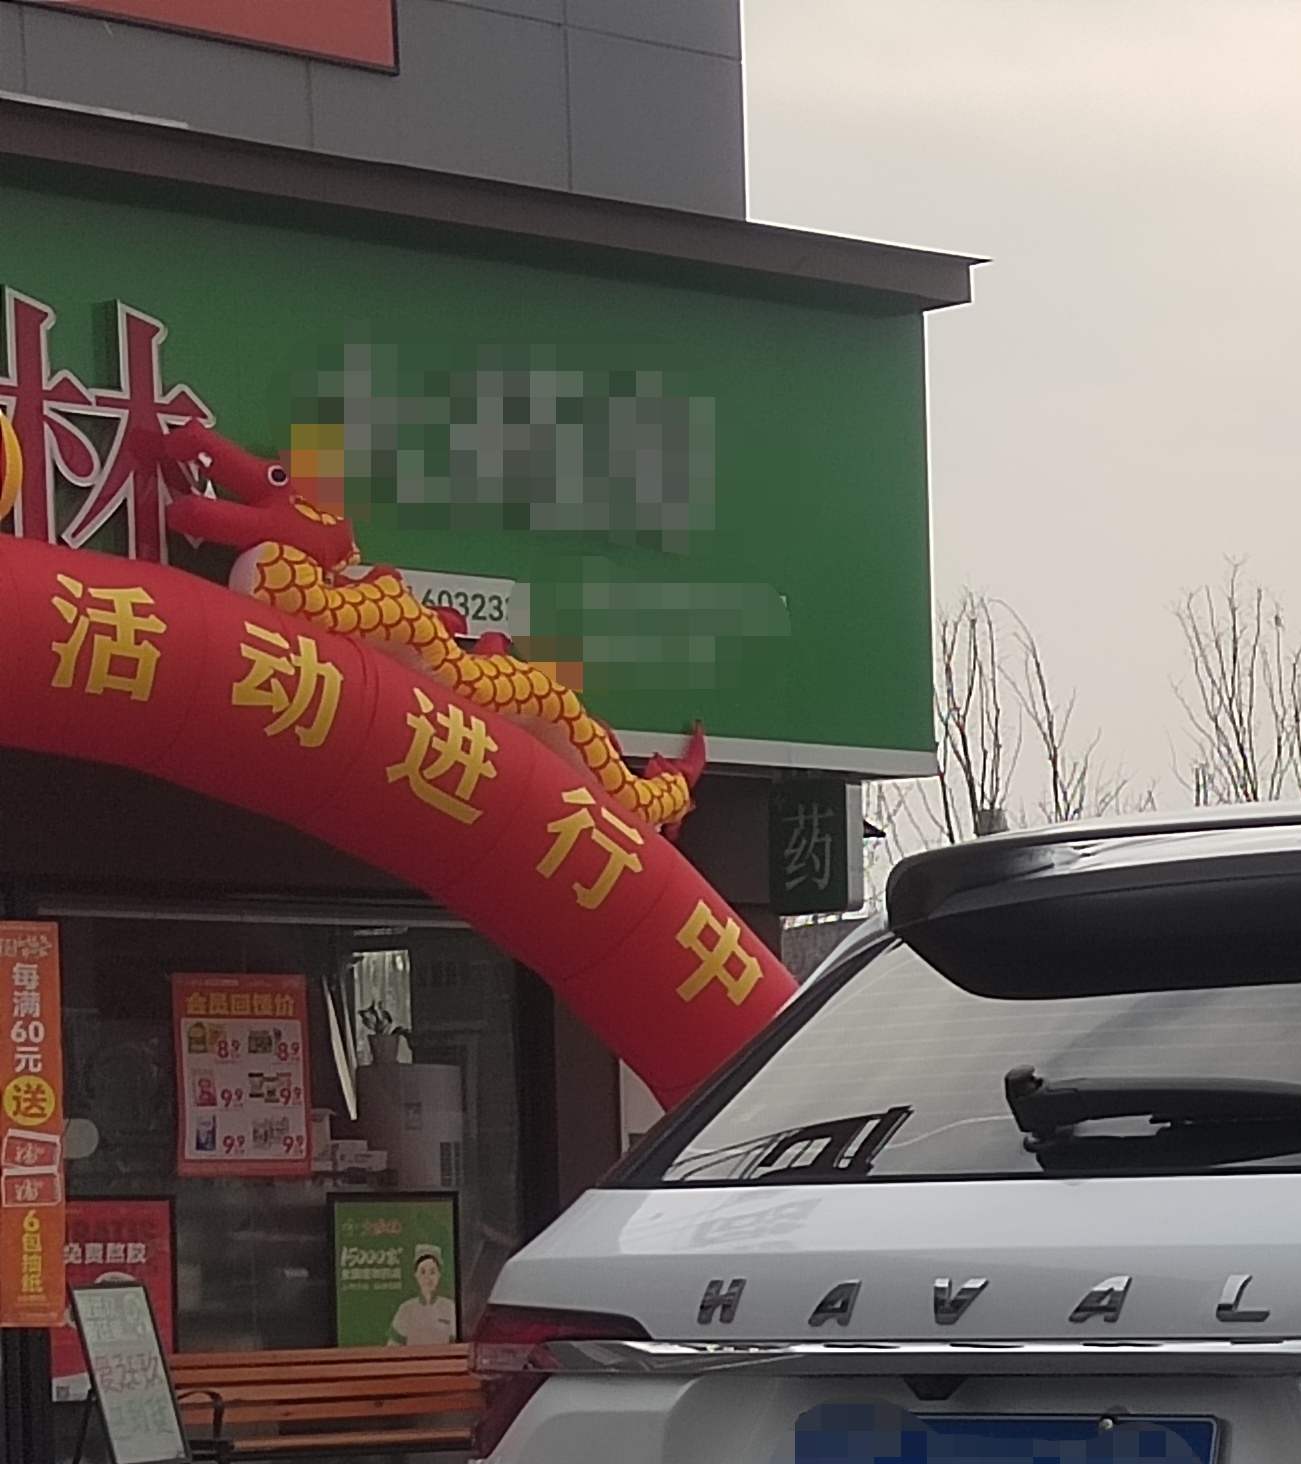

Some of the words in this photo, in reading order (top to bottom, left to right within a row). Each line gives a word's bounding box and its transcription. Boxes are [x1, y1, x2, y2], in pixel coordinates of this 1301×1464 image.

[51, 573, 764, 1008] 活动进行中
[782, 803, 836, 891] 药
[186, 991, 295, 1017] 会员回馈价
[12, 1084, 49, 1119] 送
[696, 1274, 1272, 1327] HAVAL
